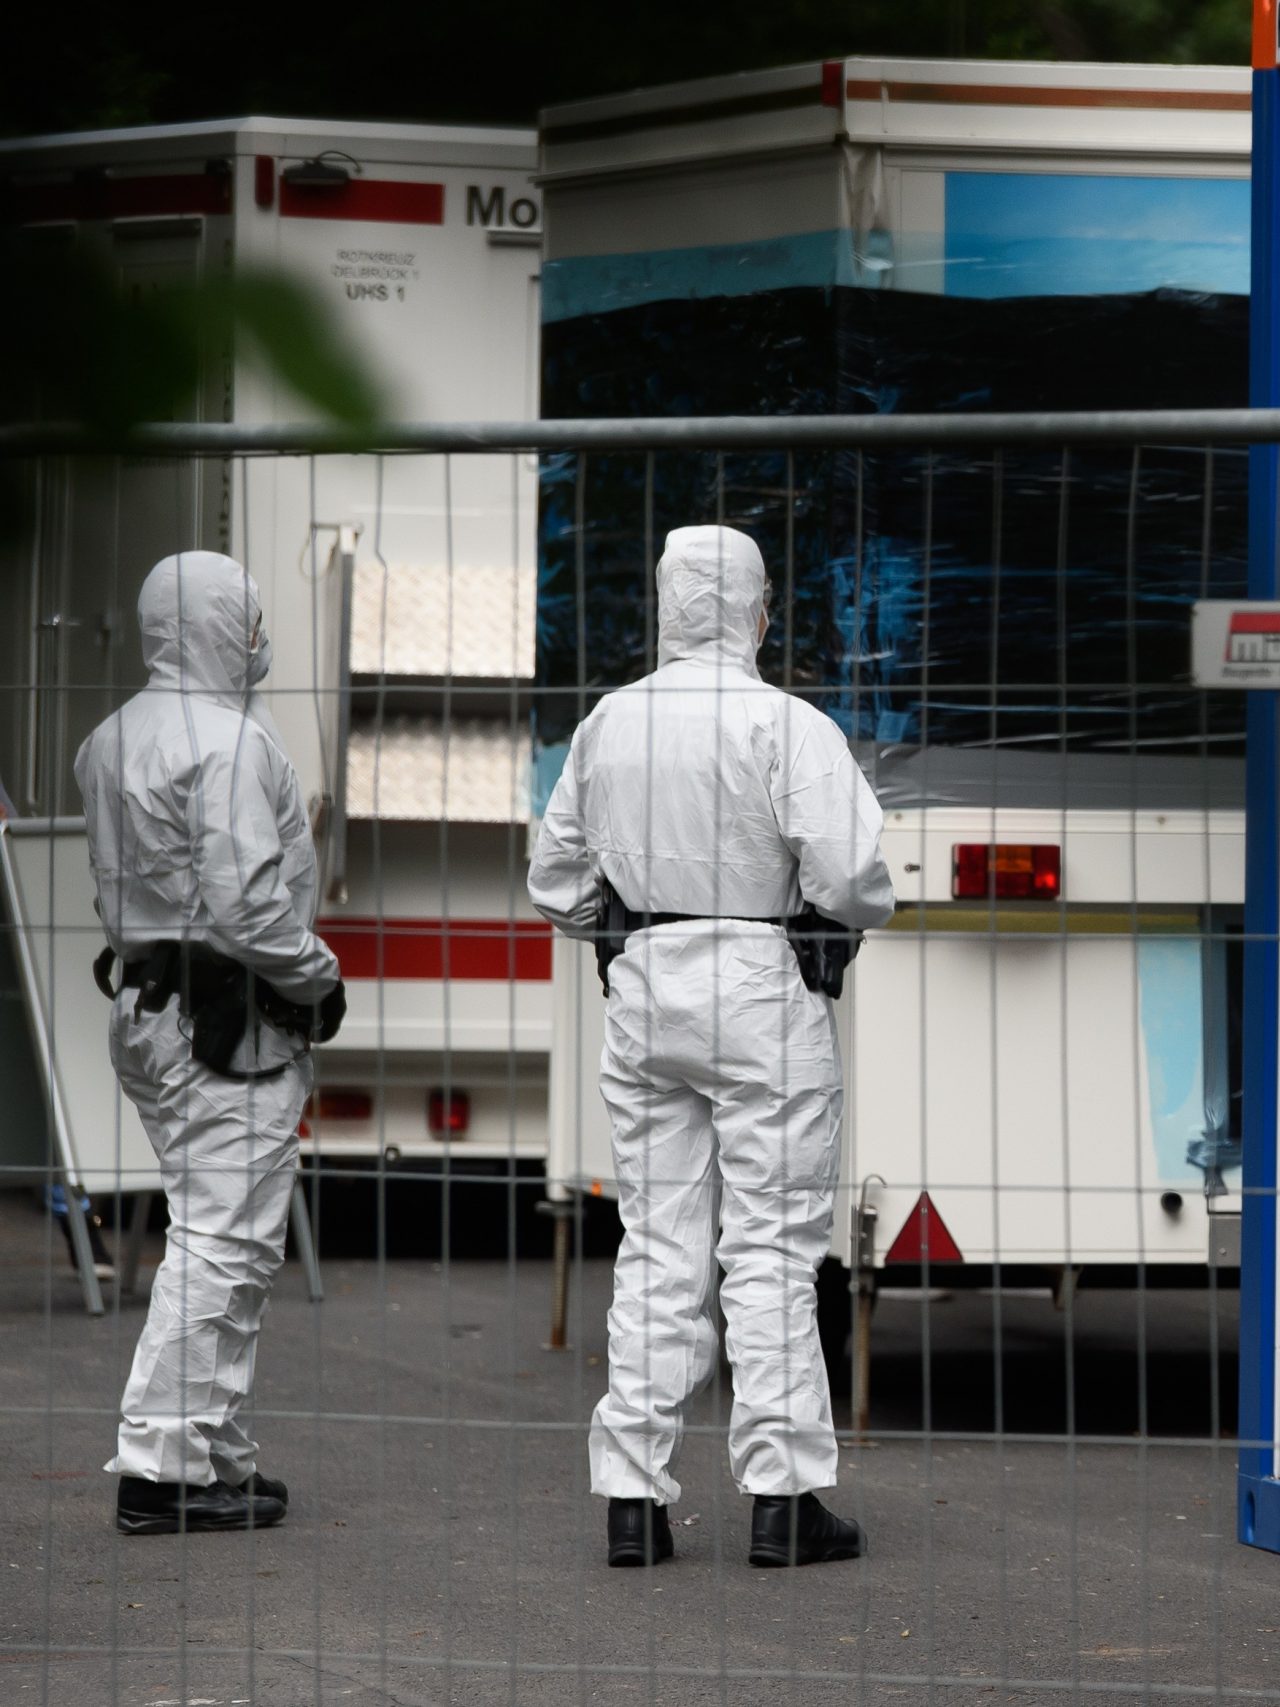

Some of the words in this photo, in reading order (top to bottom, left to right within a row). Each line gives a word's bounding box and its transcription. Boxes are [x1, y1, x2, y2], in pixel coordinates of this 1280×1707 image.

[466, 185, 538, 228] Mo
[347, 284, 389, 301] UHS
[396, 286, 405, 302] 1
